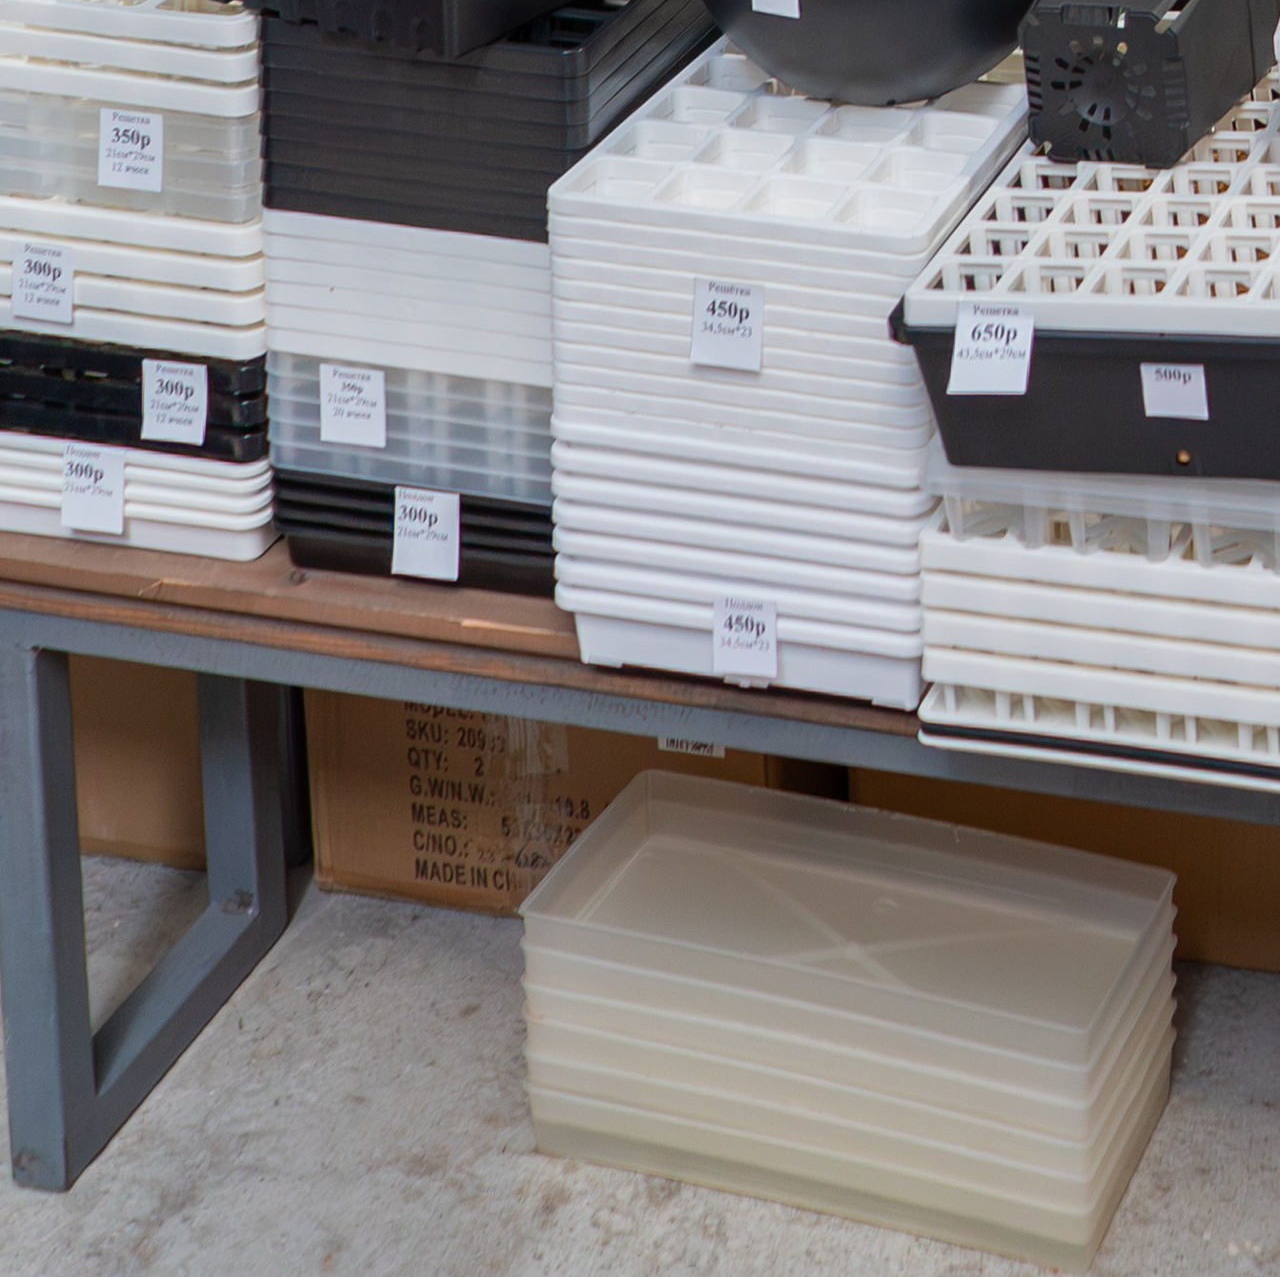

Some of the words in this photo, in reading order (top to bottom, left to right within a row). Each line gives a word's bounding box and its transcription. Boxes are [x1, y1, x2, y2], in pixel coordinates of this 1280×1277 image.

[407, 748, 449, 772] QTY:
[411, 803, 468, 830] MEAS:
[414, 859, 468, 887] MADE
[469, 864, 488, 888] IN
